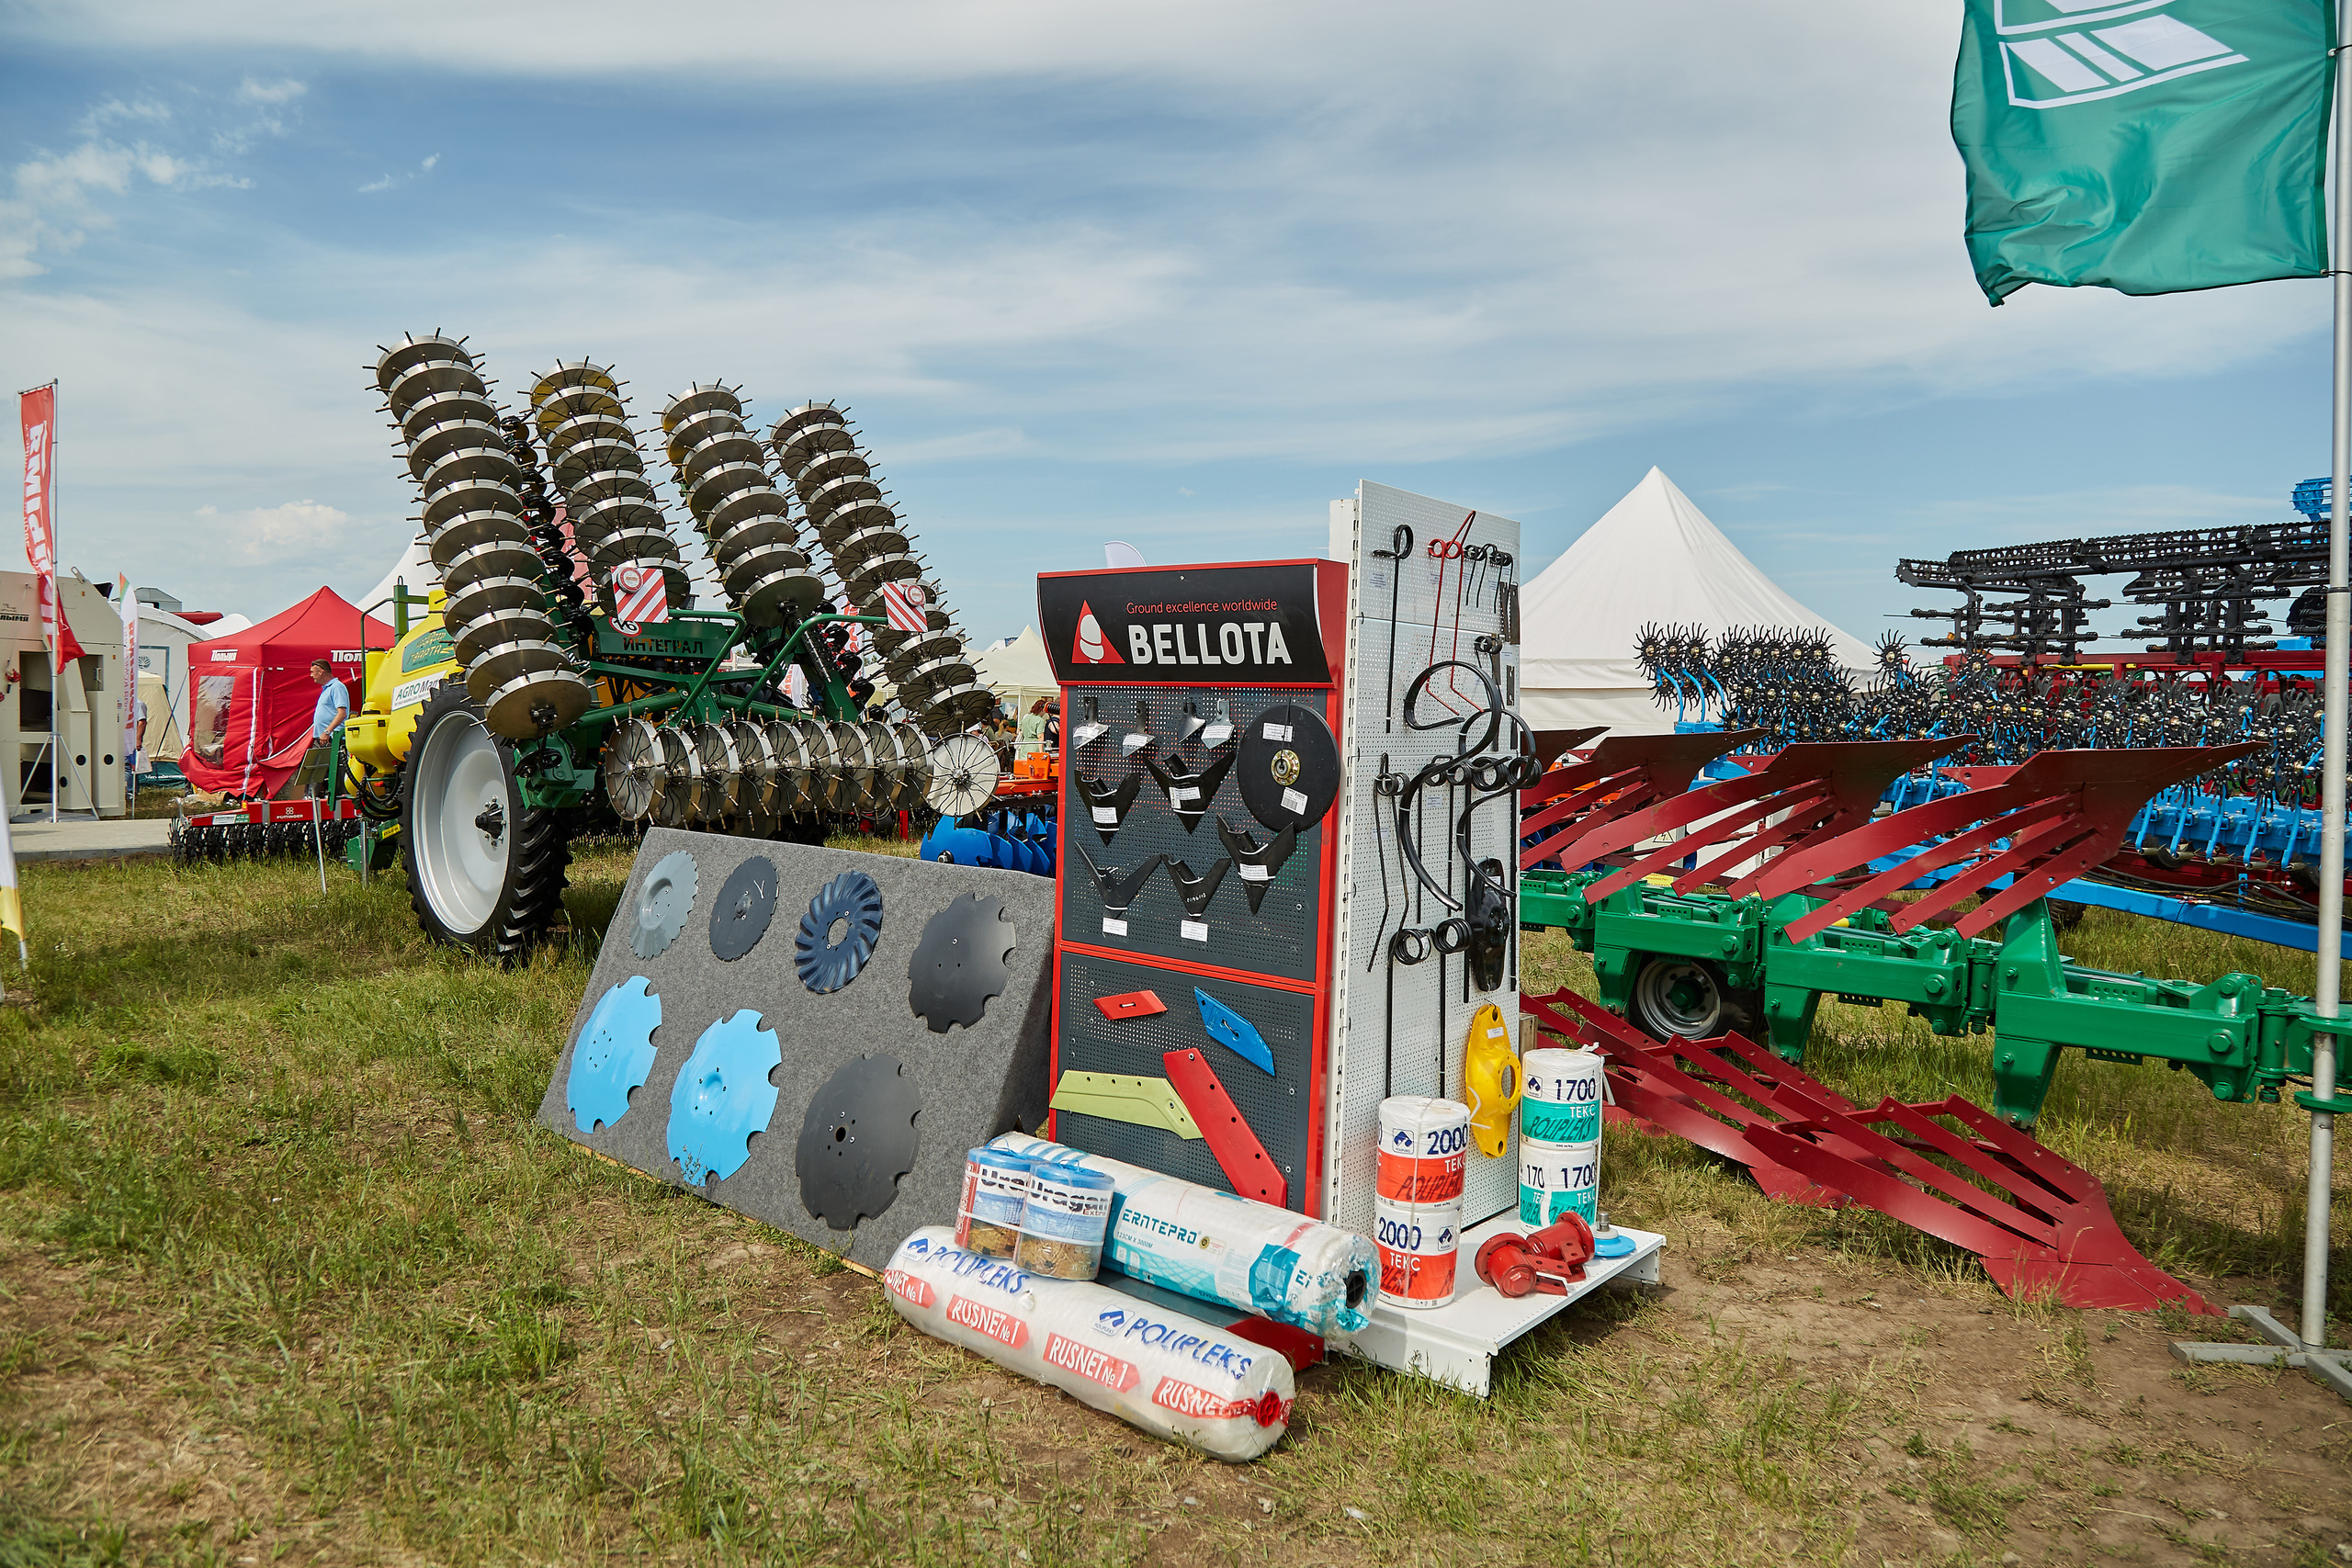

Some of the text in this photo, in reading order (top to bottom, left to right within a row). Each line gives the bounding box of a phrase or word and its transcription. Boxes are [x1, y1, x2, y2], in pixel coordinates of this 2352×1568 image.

[1126, 598, 1277, 614] Ground excellence worldwide
[331, 649, 367, 662] Пол
[623, 637, 704, 654] ИНТЕГРАЛ
[1127, 622, 1293, 665] BELLOTA
[1555, 1077, 1596, 1101] 1700
[1427, 1123, 1468, 1155] 2000
[1529, 1115, 1595, 1141] POLIPLEKS
[981, 1168, 1029, 1192] Ura
[1527, 1165, 1544, 1189] 170
[1561, 1162, 1596, 1189] 1700
[1031, 1179, 1108, 1213] Uragan
[1378, 1217, 1421, 1251] 2000
[925, 1246, 1030, 1294] POLIPLEKS
[951, 1299, 1007, 1337] RUSNET
[1048, 1337, 1109, 1379] RUSNET
[1124, 1317, 1252, 1380] POLIPLEKS
[1158, 1380, 1229, 1416] RUSNET
